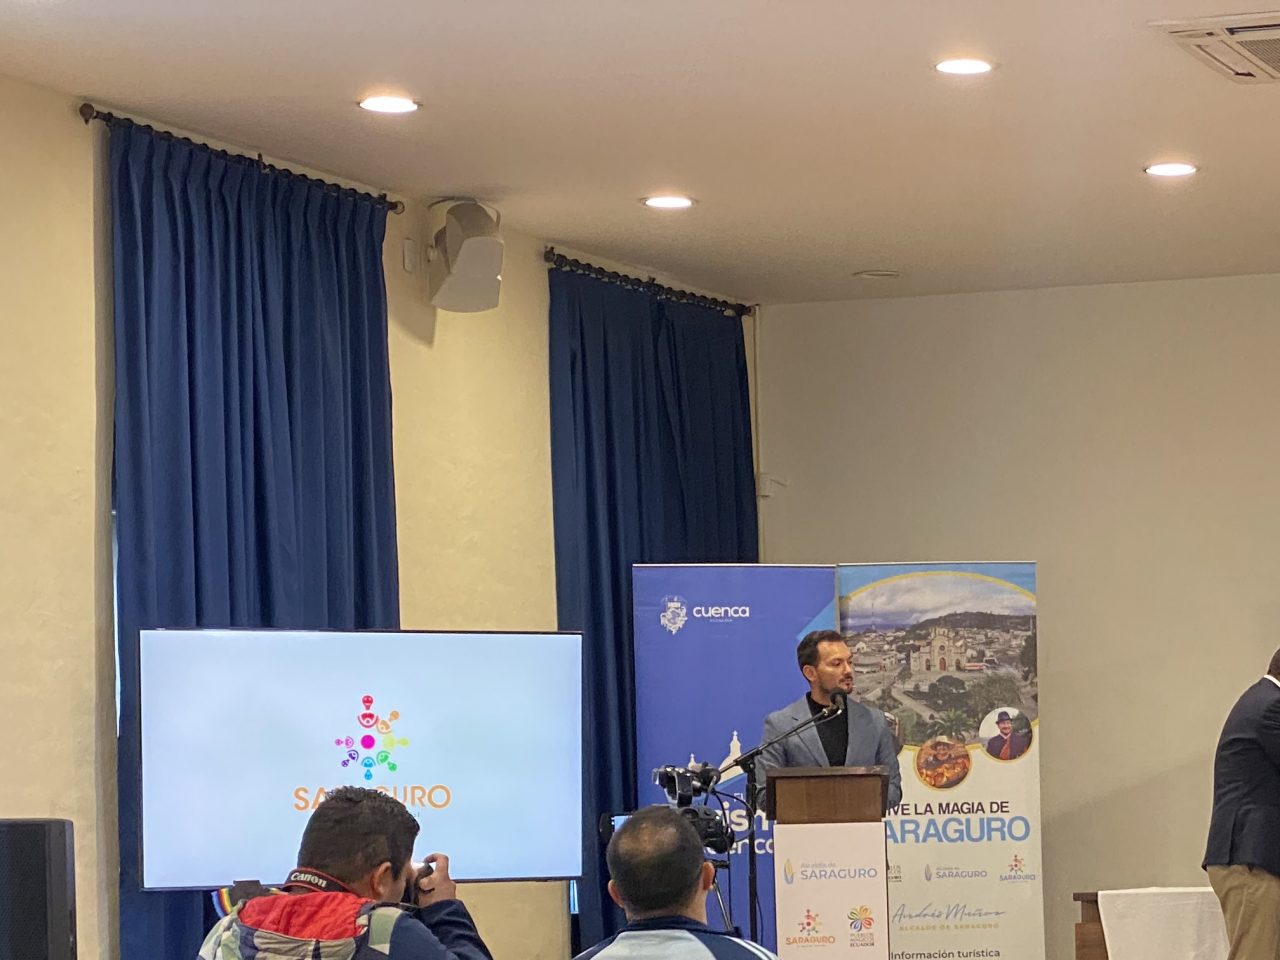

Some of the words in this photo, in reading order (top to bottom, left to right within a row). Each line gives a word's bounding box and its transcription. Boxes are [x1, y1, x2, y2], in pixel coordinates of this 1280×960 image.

[692, 605, 750, 618] cuenca
[887, 803, 911, 817] IVE
[914, 803, 934, 816] LA
[938, 801, 986, 815] MAGIA
[989, 801, 1010, 814] DE
[886, 815, 1031, 844] ARAGURO
[290, 871, 328, 888] Canon
[800, 867, 878, 880] SARAGURO
[935, 869, 988, 880] SARAGURO
[785, 935, 836, 946] SARAGURO
[890, 950, 955, 960] Información
[957, 948, 1001, 959] turística
